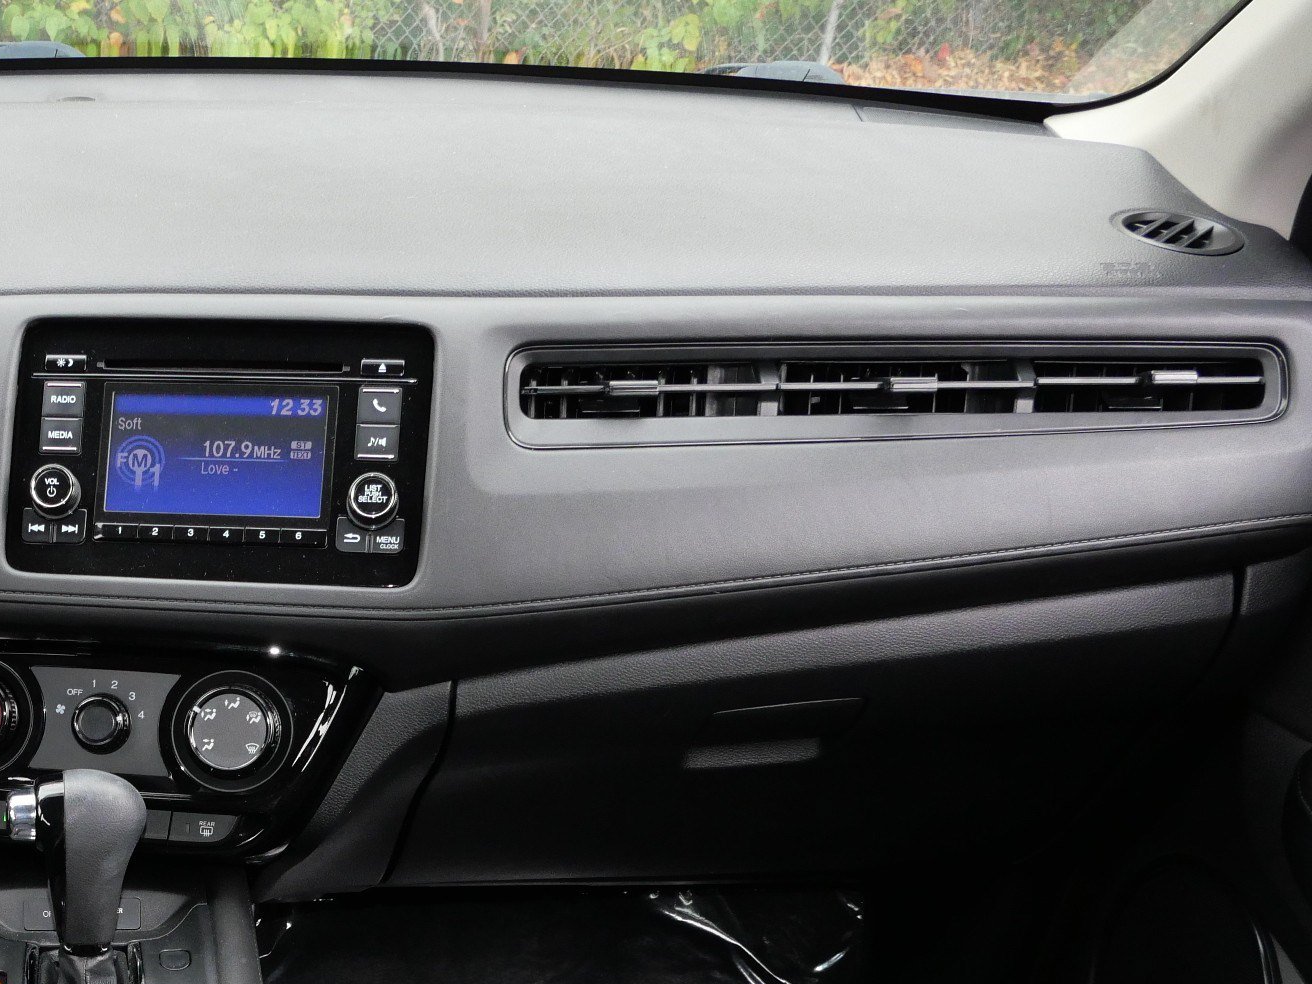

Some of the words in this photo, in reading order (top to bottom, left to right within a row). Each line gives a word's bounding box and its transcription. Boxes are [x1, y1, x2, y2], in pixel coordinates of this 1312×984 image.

[50, 395, 76, 404] RADIO
[118, 417, 142, 430] Soft
[48, 430, 73, 439] MEDIA
[203, 440, 252, 458] 107.9
[254, 445, 281, 459] MHz
[201, 463, 229, 475] Love
[358, 495, 388, 503] SELECT
[152, 528, 159, 536] 2
[187, 528, 194, 537] 3
[223, 530, 230, 538] 4
[259, 531, 266, 539] 5
[295, 532, 302, 540] 6
[376, 536, 400, 544] MENU
[111, 681, 118, 689] 2
[67, 688, 83, 696] OFF
[128, 692, 136, 701] 3
[138, 711, 145, 719] 4
